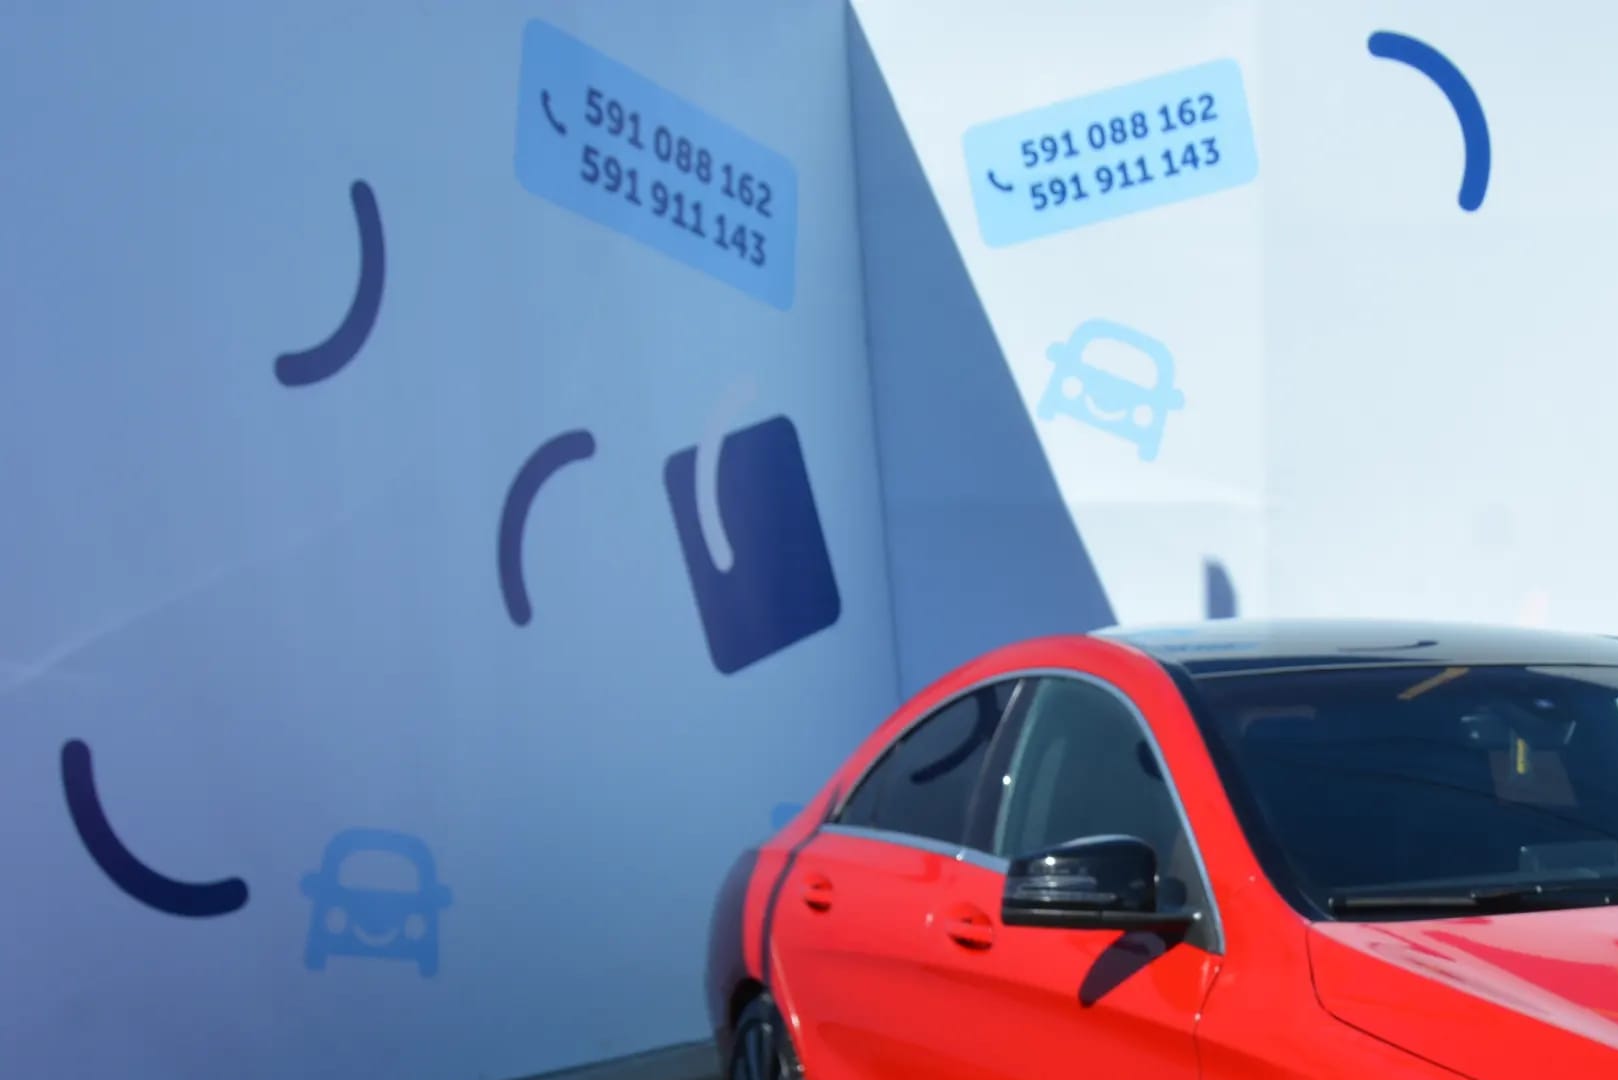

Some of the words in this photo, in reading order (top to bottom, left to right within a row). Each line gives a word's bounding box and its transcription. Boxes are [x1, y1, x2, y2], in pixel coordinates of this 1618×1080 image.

[585, 88, 645, 149] 591
[655, 126, 713, 184] 088
[722, 163, 772, 219] 162
[1021, 130, 1080, 169] 591
[1087, 111, 1149, 151] 088
[1158, 94, 1218, 133] 162
[1030, 173, 1089, 211] 591
[1095, 155, 1154, 193] 911
[1161, 138, 1221, 177] 143
[581, 147, 642, 207] 591
[651, 181, 706, 239] 911
[714, 215, 767, 268] 143
